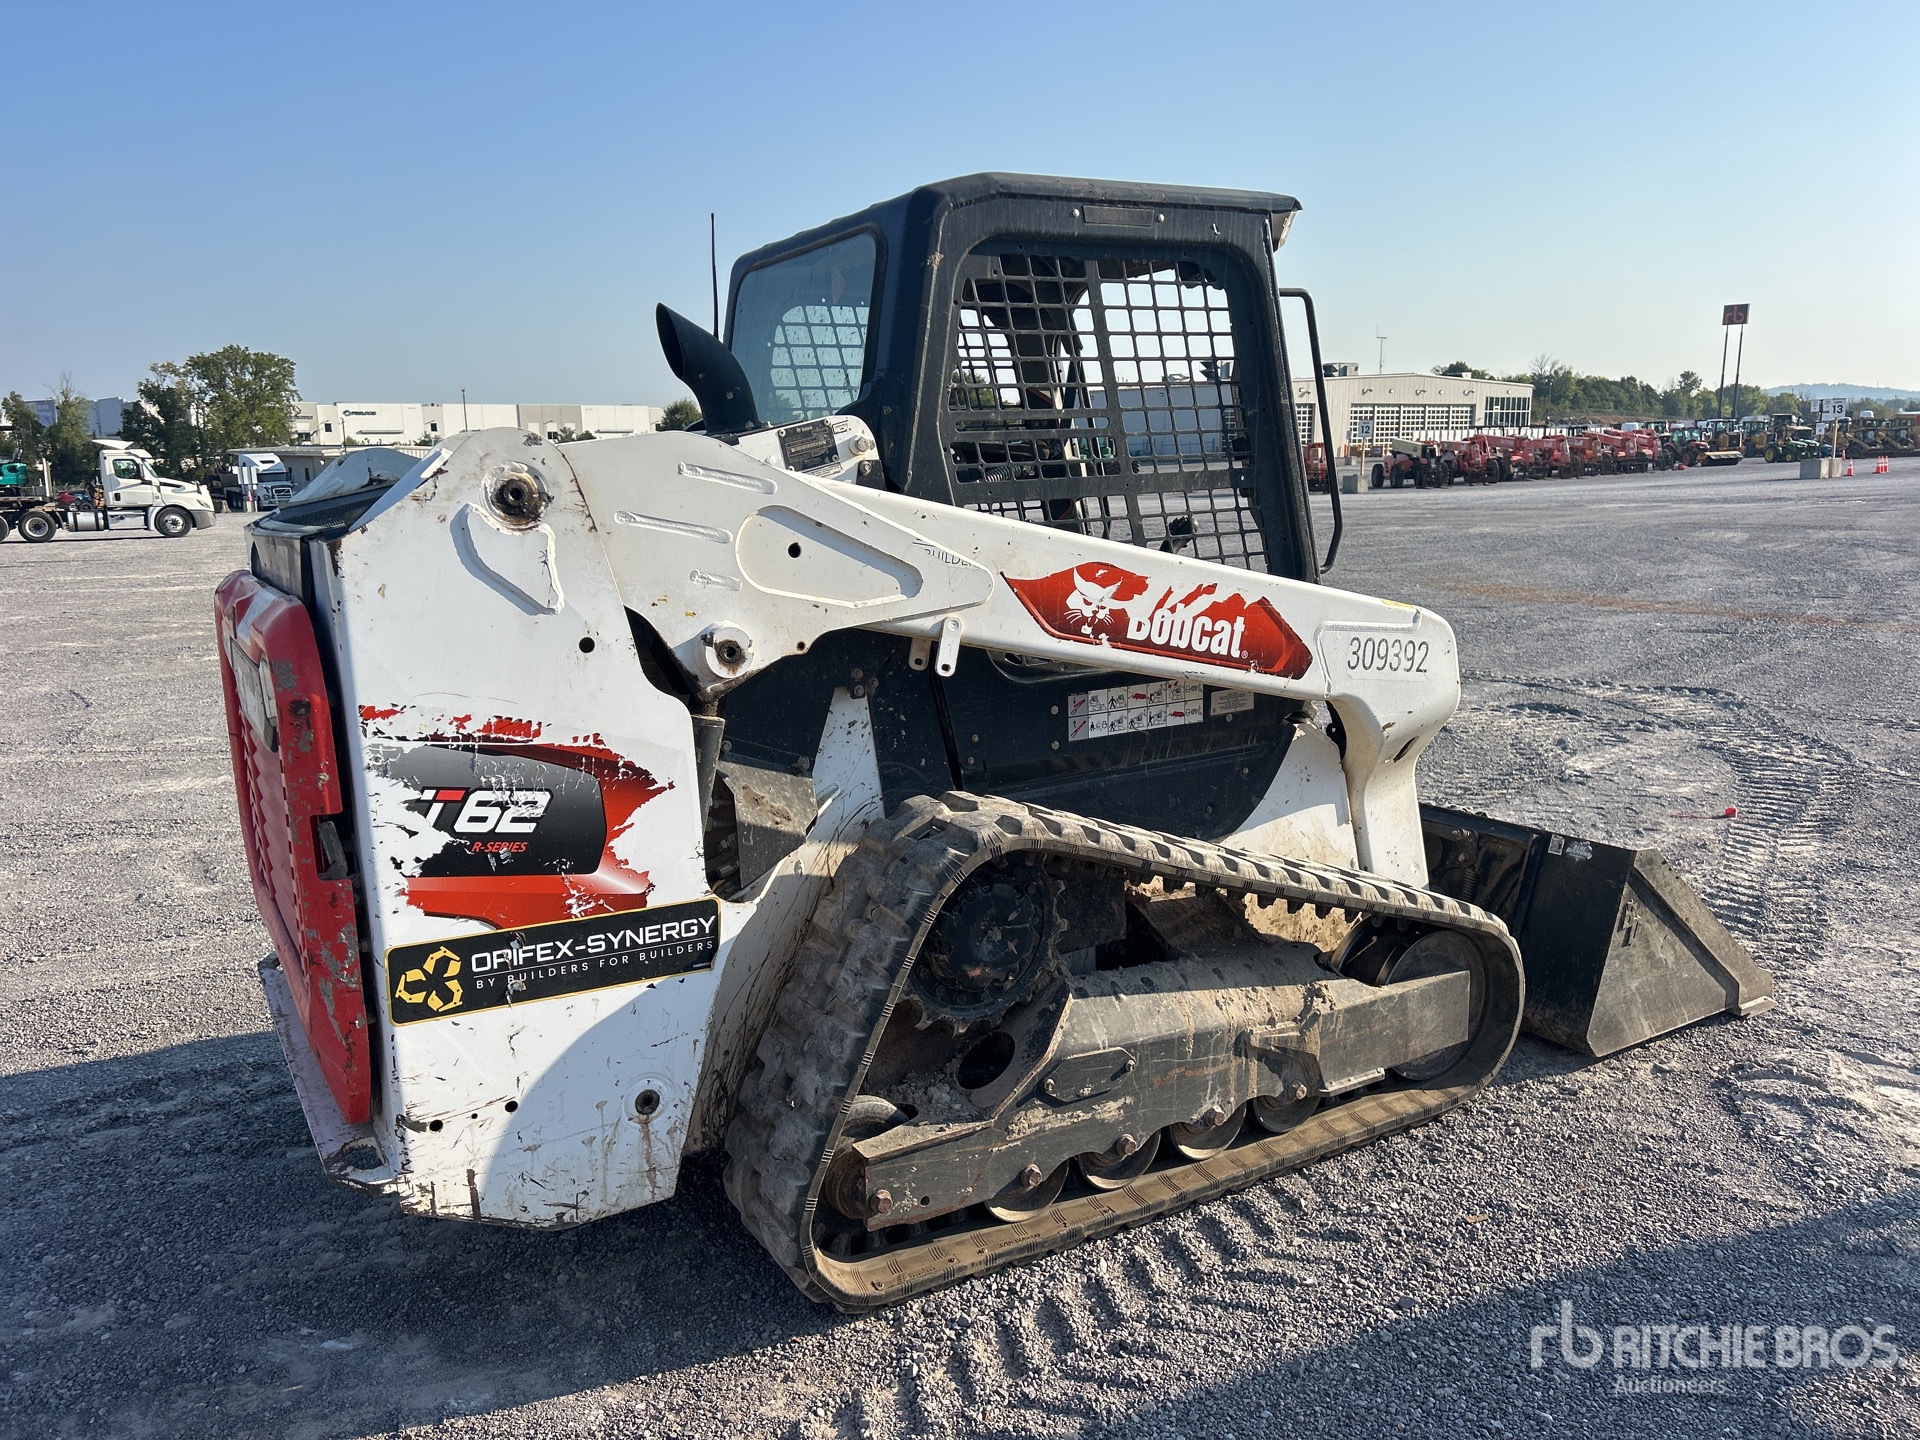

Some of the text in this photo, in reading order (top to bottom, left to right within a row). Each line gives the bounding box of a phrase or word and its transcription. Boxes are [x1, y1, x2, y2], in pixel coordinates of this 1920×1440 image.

[1832, 404, 1844, 414] 13
[1361, 425, 1371, 434] 12
[1126, 602, 1245, 658] Bobcat
[1347, 637, 1429, 673] 309392
[471, 841, 528, 853] R-SERIES
[471, 915, 716, 973] OPIFEX-SYNERGY
[476, 940, 714, 989] BY BUILDERS FOR BUILDERS
